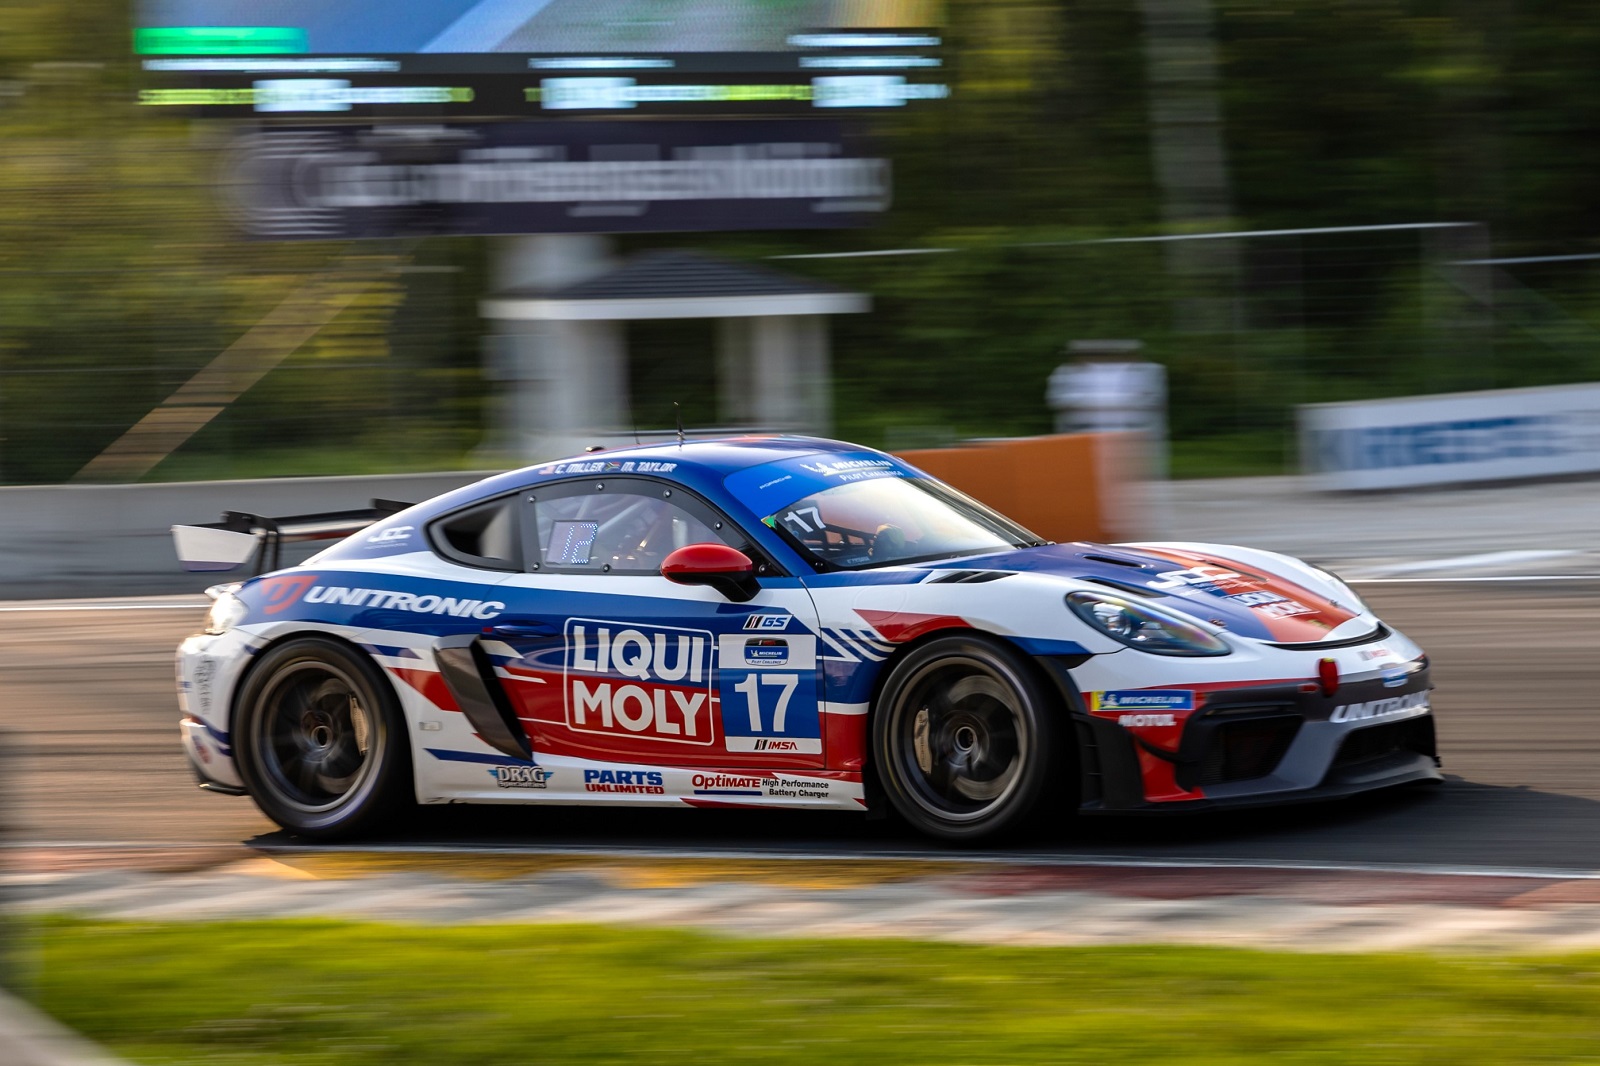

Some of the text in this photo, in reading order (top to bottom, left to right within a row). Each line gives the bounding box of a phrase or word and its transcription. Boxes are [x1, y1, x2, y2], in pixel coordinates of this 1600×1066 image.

[566, 461, 605, 474] MILLER
[636, 461, 678, 473] TAYLOR
[830, 459, 894, 470] MICHELIN
[784, 506, 827, 533] 17
[562, 523, 598, 564] 12
[303, 585, 507, 620] UNITRONIC
[761, 617, 788, 628] GS
[573, 625, 704, 683] LIQUI
[734, 673, 799, 732] 17
[1118, 696, 1185, 704] MICHELIN
[572, 680, 707, 737] MOLY
[1118, 714, 1177, 727] MOTUL
[768, 741, 798, 751] IMSA
[496, 766, 544, 783] DRAG
[584, 769, 663, 786] PARTS
[585, 783, 665, 795] UNLIMITED
[762, 778, 829, 788] High Performance
[769, 788, 829, 798] Battery Charger
